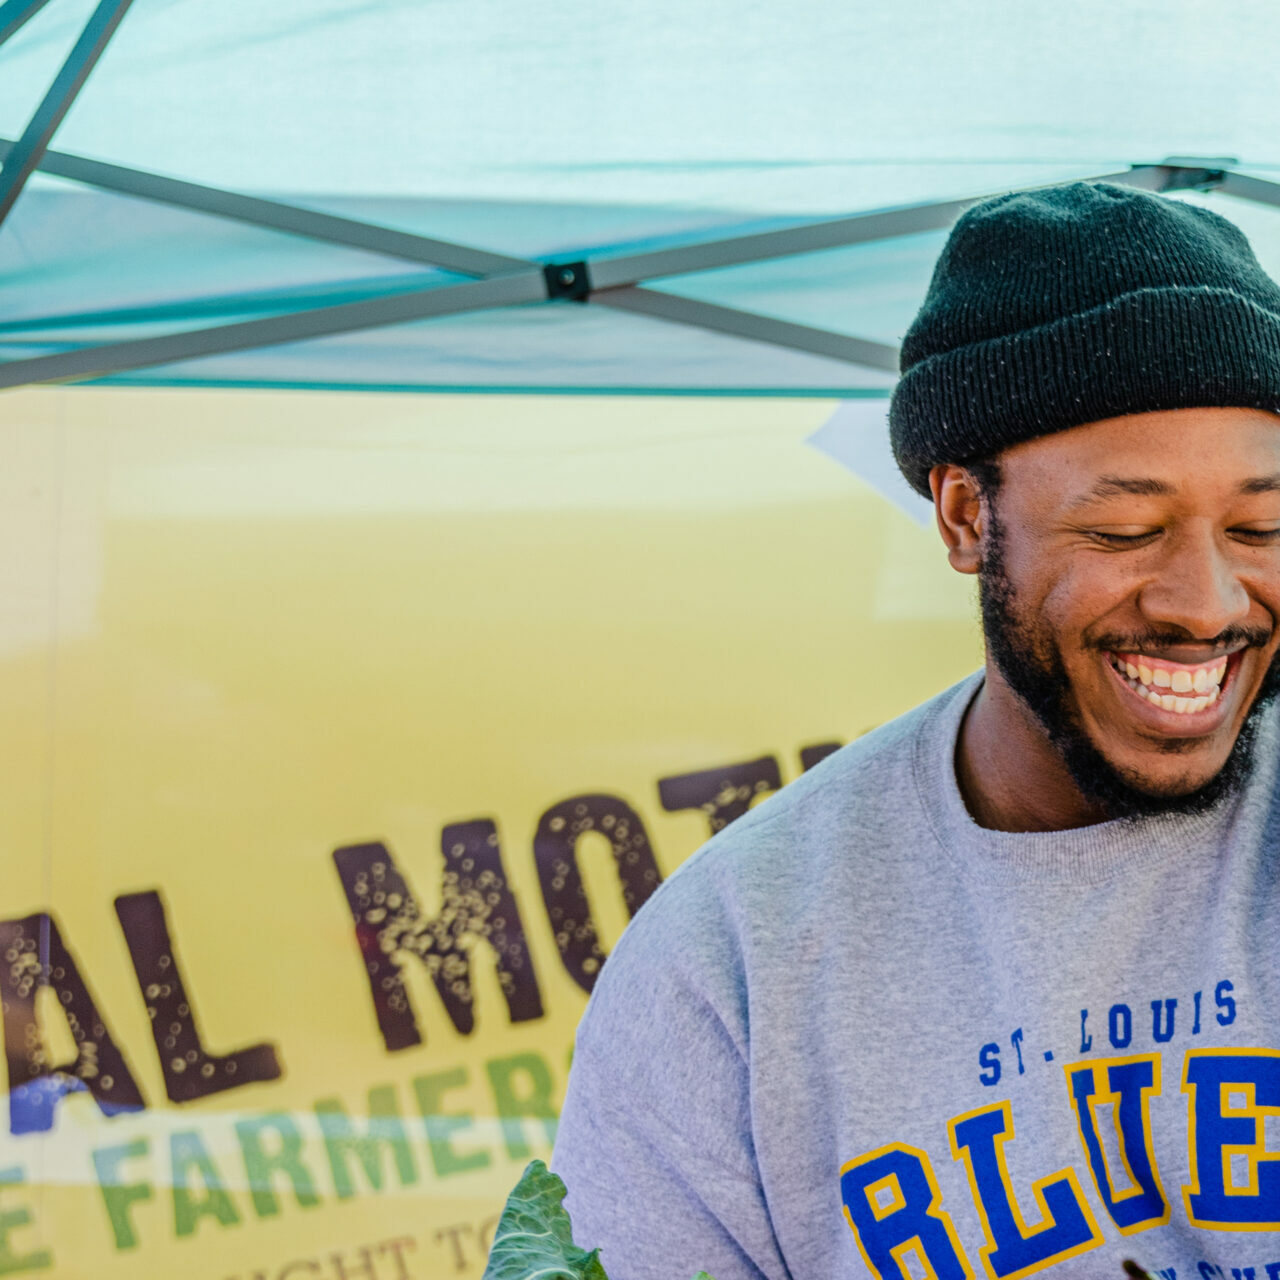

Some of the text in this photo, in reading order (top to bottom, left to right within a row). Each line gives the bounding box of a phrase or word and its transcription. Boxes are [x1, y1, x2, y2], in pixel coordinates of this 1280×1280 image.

[332, 738, 845, 1053] MOT
[1080, 980, 1237, 1053] LOUIS
[92, 1050, 571, 1250] FARMER
